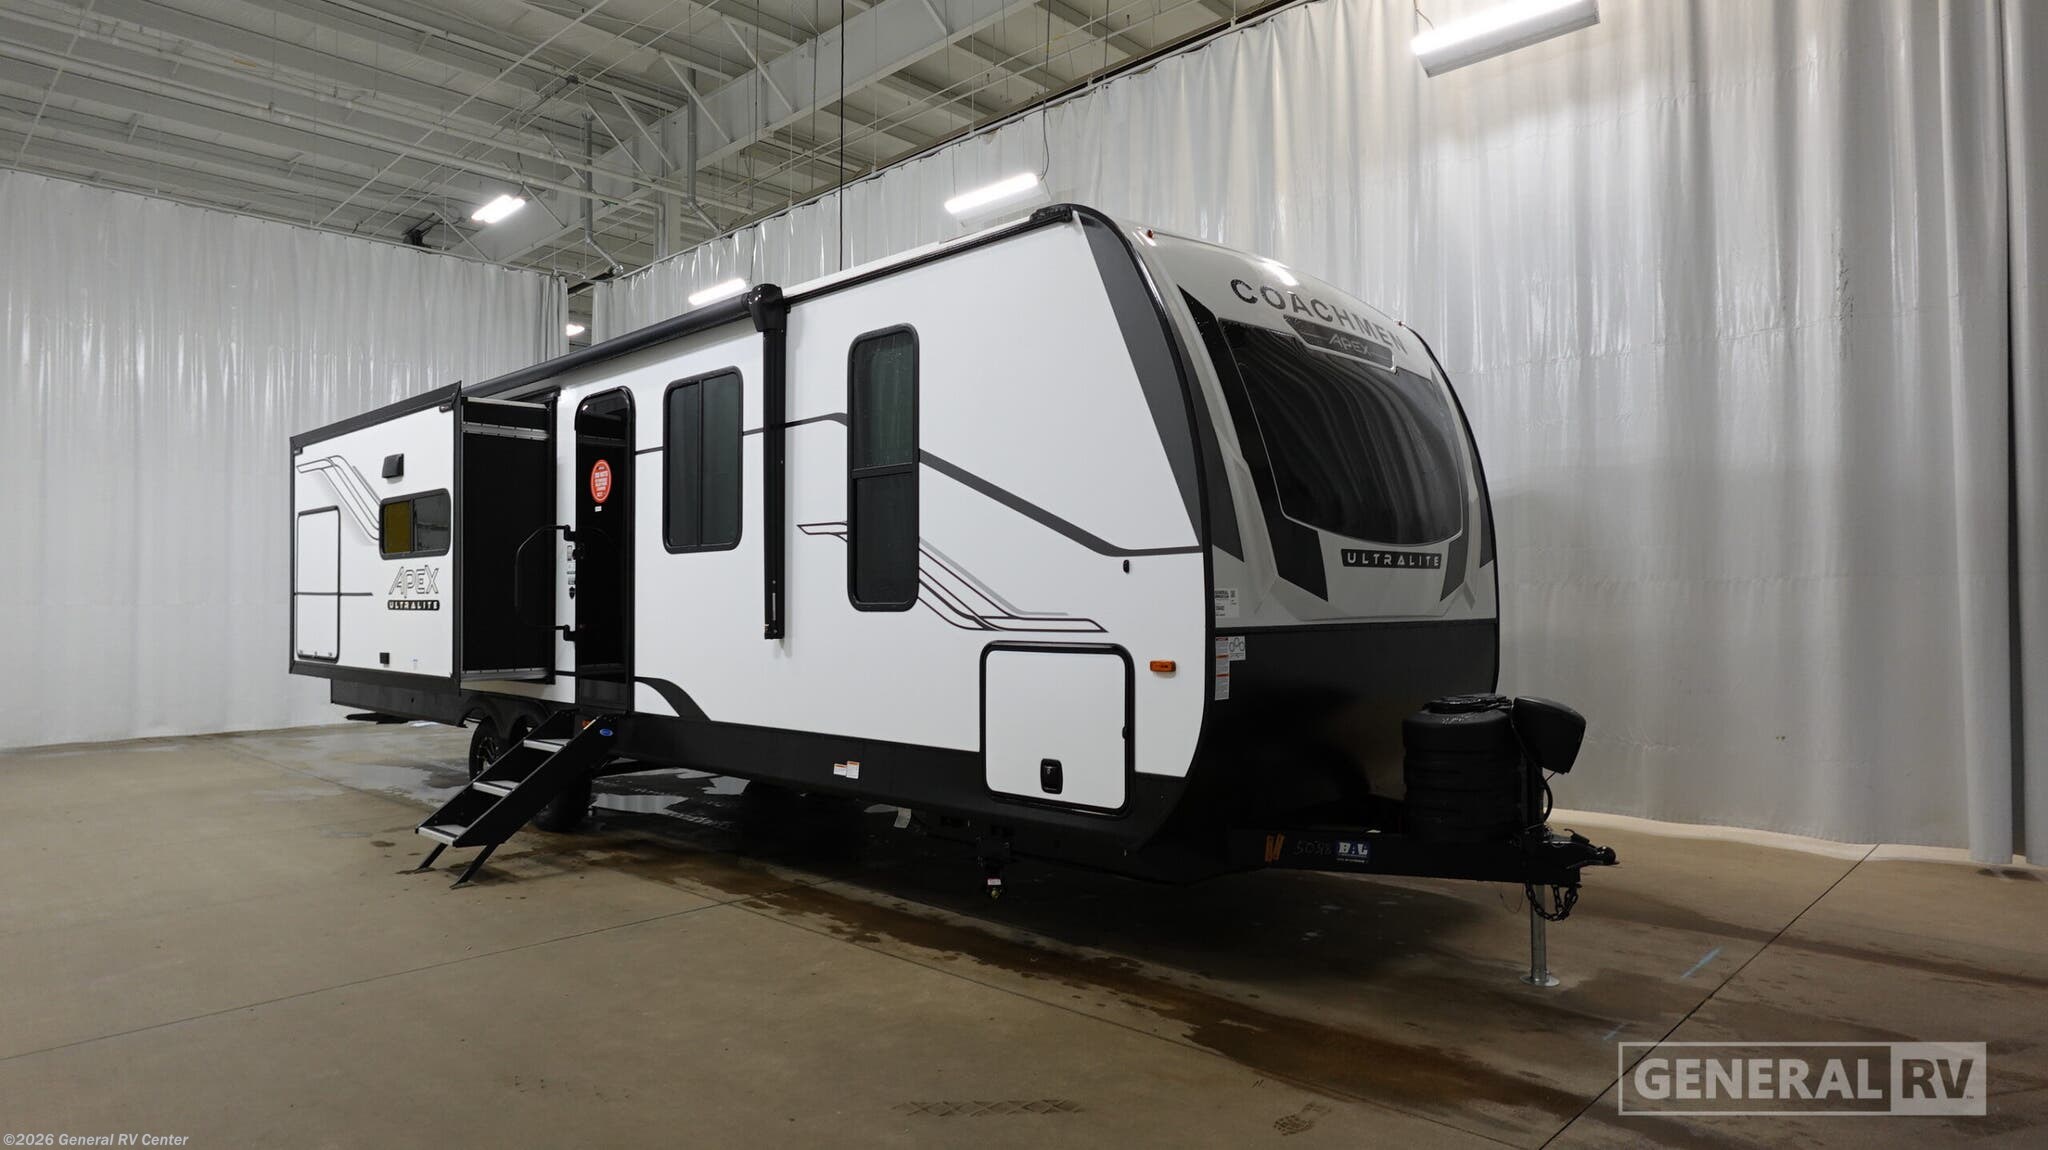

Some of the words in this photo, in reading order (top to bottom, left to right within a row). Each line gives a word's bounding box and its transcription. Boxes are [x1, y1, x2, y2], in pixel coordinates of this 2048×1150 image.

[1230, 279, 1408, 355] COACHMEN
[1328, 333, 1369, 355] APEX
[1346, 552, 1440, 567] ULTRALITE
[388, 564, 440, 599] APEX
[388, 600, 439, 610] ULTRALITE
